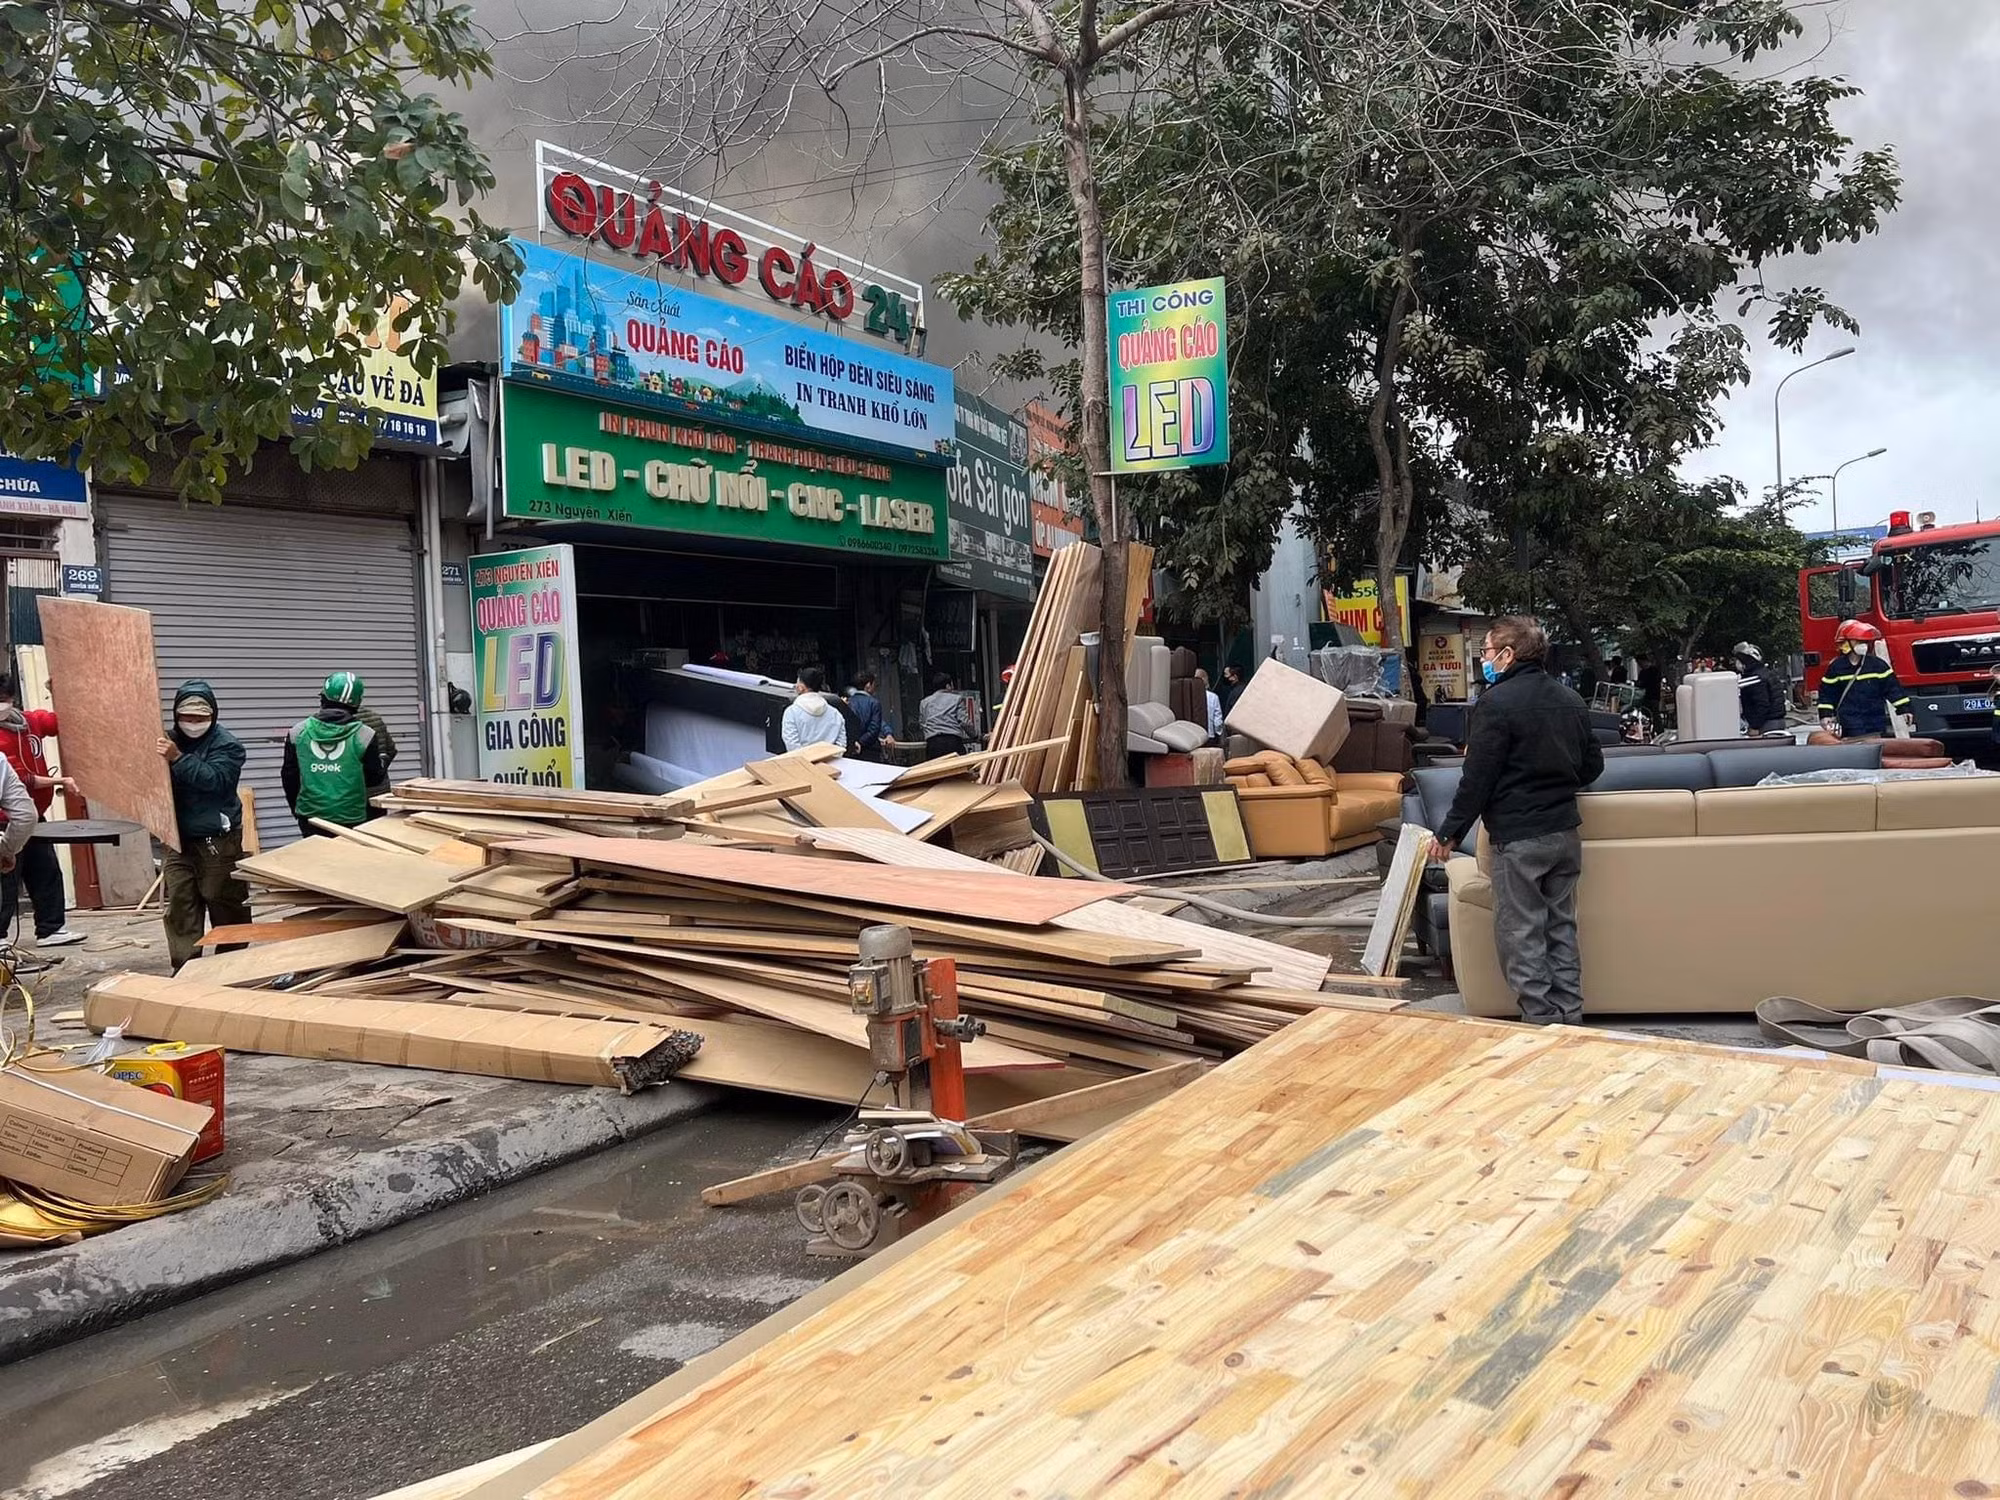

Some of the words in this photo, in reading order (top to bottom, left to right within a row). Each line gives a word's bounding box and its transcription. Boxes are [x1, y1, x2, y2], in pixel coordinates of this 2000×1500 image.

[545, 171, 749, 285] QUẢNG
[759, 242, 855, 320] CÁO
[1117, 300, 1146, 318] THI
[1151, 288, 1215, 313] CÔNG
[627, 317, 699, 364] QUẢNG
[706, 338, 744, 374] CÁO
[1118, 319, 1177, 372] QUẢNG
[1180, 315, 1219, 360] CÁO
[371, 366, 395, 401] VỀ
[400, 377, 425, 407] ĐÁ
[785, 342, 816, 373] BIỂN
[820, 354, 845, 382] HỘP
[849, 361, 873, 387] ĐÈN
[876, 370, 902, 395] SIÊU
[905, 377, 935, 403] SÁNG
[600, 412, 621, 433] IN
[623, 417, 670, 442] PHUN
[796, 382, 813, 403] IN
[817, 387, 867, 416] TRANH
[903, 407, 928, 430] LỚN
[1121, 376, 1217, 462] LED
[529, 500, 551, 514] 273
[542, 443, 617, 491] LED
[645, 457, 714, 504] CHỮ
[715, 460, 768, 511] NỔI
[788, 482, 844, 522] CNC
[859, 493, 935, 534] LASER
[975, 458, 999, 519] Sài
[1003, 473, 1028, 536] gòn
[68, 569, 98, 582] 269
[442, 565, 460, 576] 271
[476, 584, 528, 634] QUẢNG
[530, 582, 562, 625] CÁO
[482, 632, 565, 713] LED
[485, 720, 513, 751] GIA
[518, 713, 566, 748] CÔNG
[310, 762, 342, 773] gojek
